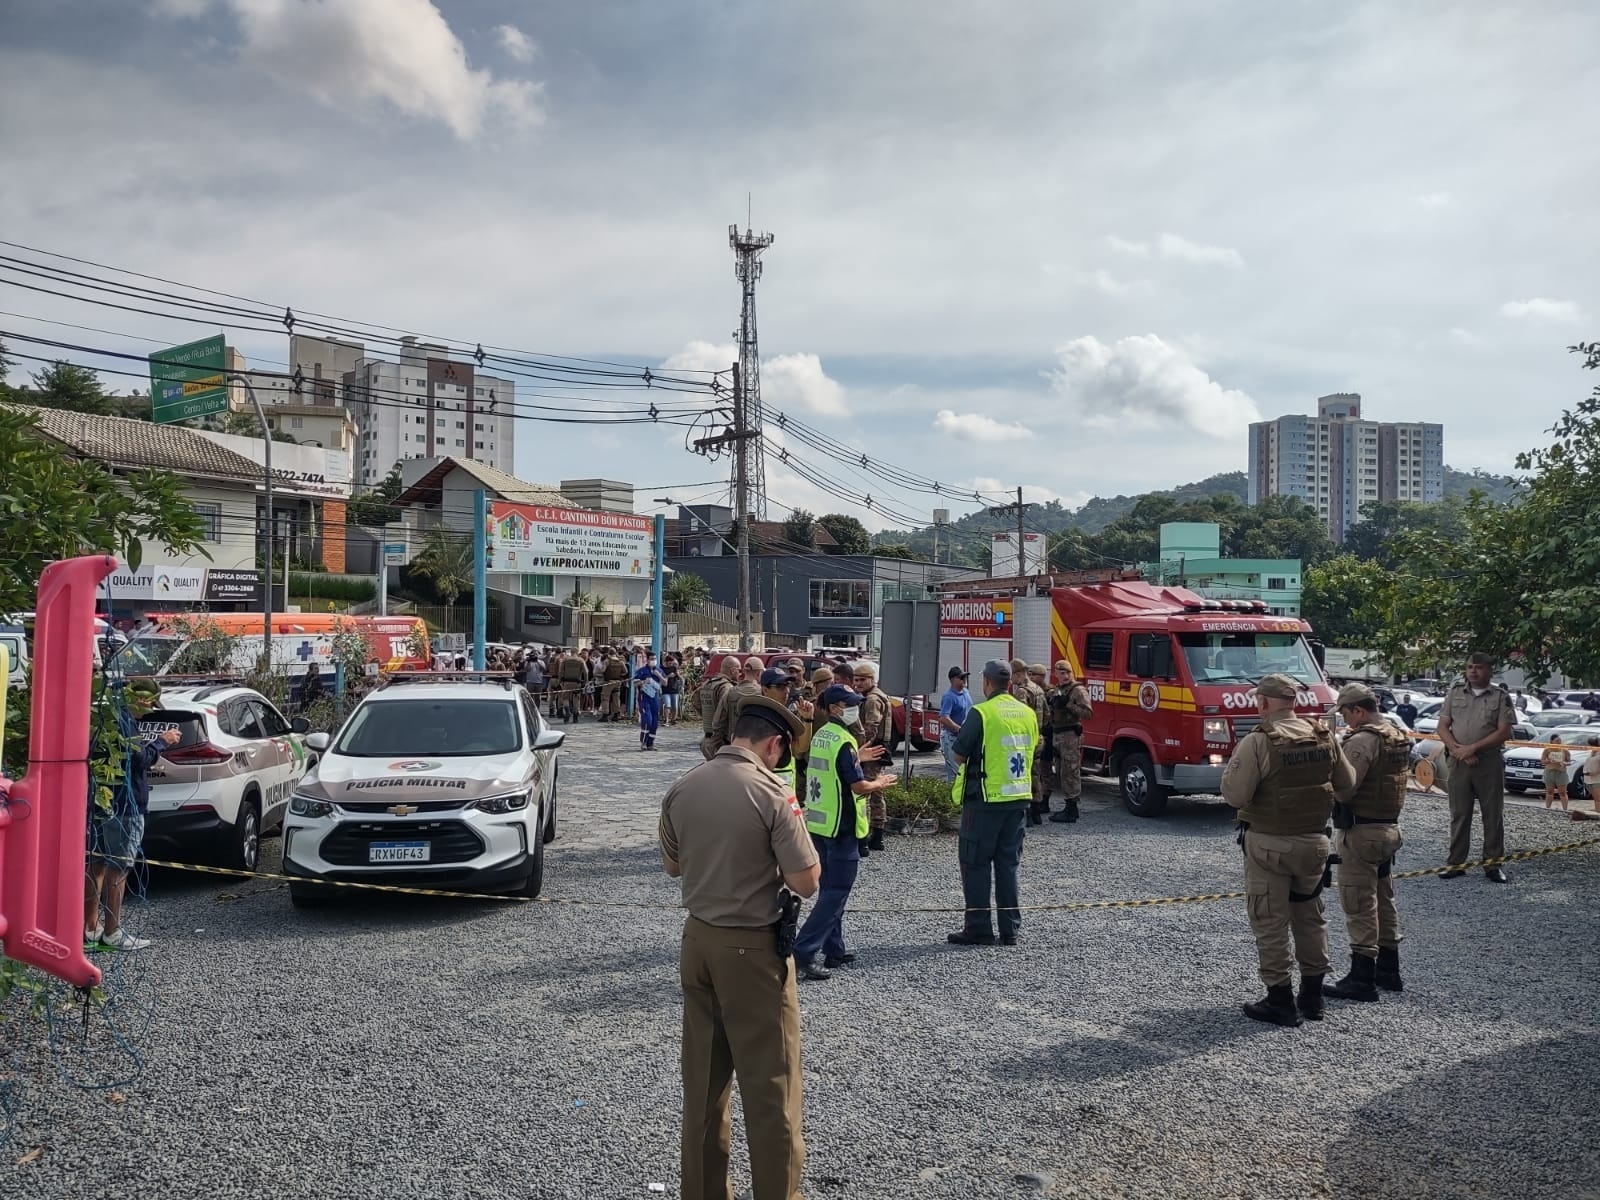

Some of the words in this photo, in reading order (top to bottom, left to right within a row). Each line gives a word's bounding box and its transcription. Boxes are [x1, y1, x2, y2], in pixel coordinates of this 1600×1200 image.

[560, 511, 599, 524] CANTINHO
[601, 515, 618, 525] BOM
[620, 517, 646, 529] PASTOR
[537, 524, 558, 534] Escola
[560, 526, 582, 536] Infantil
[589, 529, 624, 540] Contraturno
[625, 532, 645, 542] Escolar
[555, 538, 569, 546] mais
[533, 557, 621, 571] #VEMPROCANTINHO
[112, 575, 153, 587] QUALITY
[208, 571, 235, 580] GRÁFICA
[235, 573, 259, 581] DIGITAL
[173, 577, 200, 588] QUALITY
[973, 627, 991, 637] 193
[1202, 621, 1257, 631] EMERGÊNCIA
[1272, 622, 1300, 631] 193
[1088, 684, 1105, 702] 193
[346, 779, 403, 791] POLÍCIA
[406, 778, 466, 790] MILITAR
